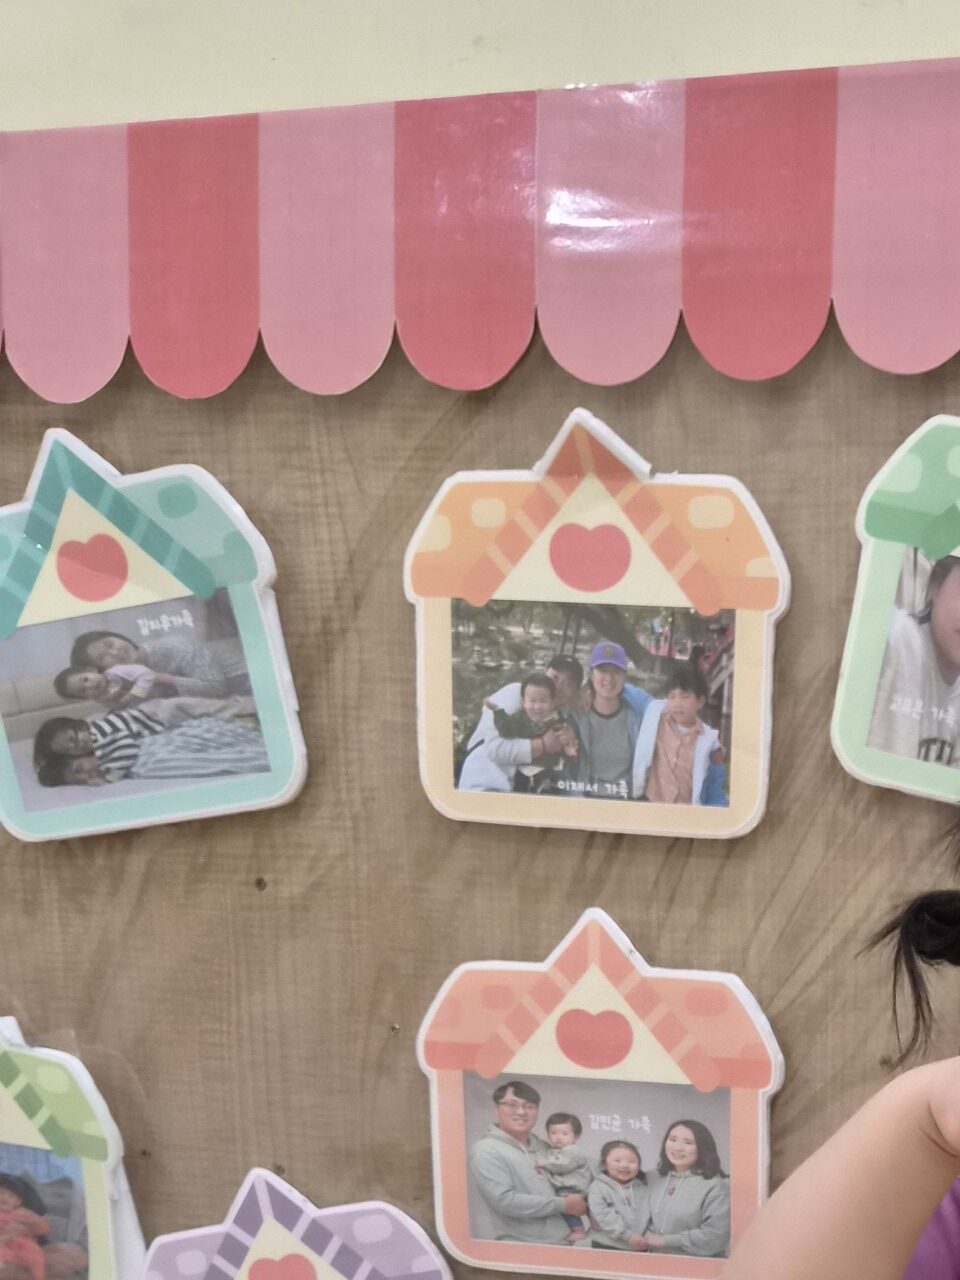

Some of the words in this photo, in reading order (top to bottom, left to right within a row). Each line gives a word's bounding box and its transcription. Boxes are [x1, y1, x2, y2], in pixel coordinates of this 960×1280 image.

[930, 704, 956, 727] 가족
[604, 779, 628, 800] 가족
[628, 1115, 651, 1134] 가족
